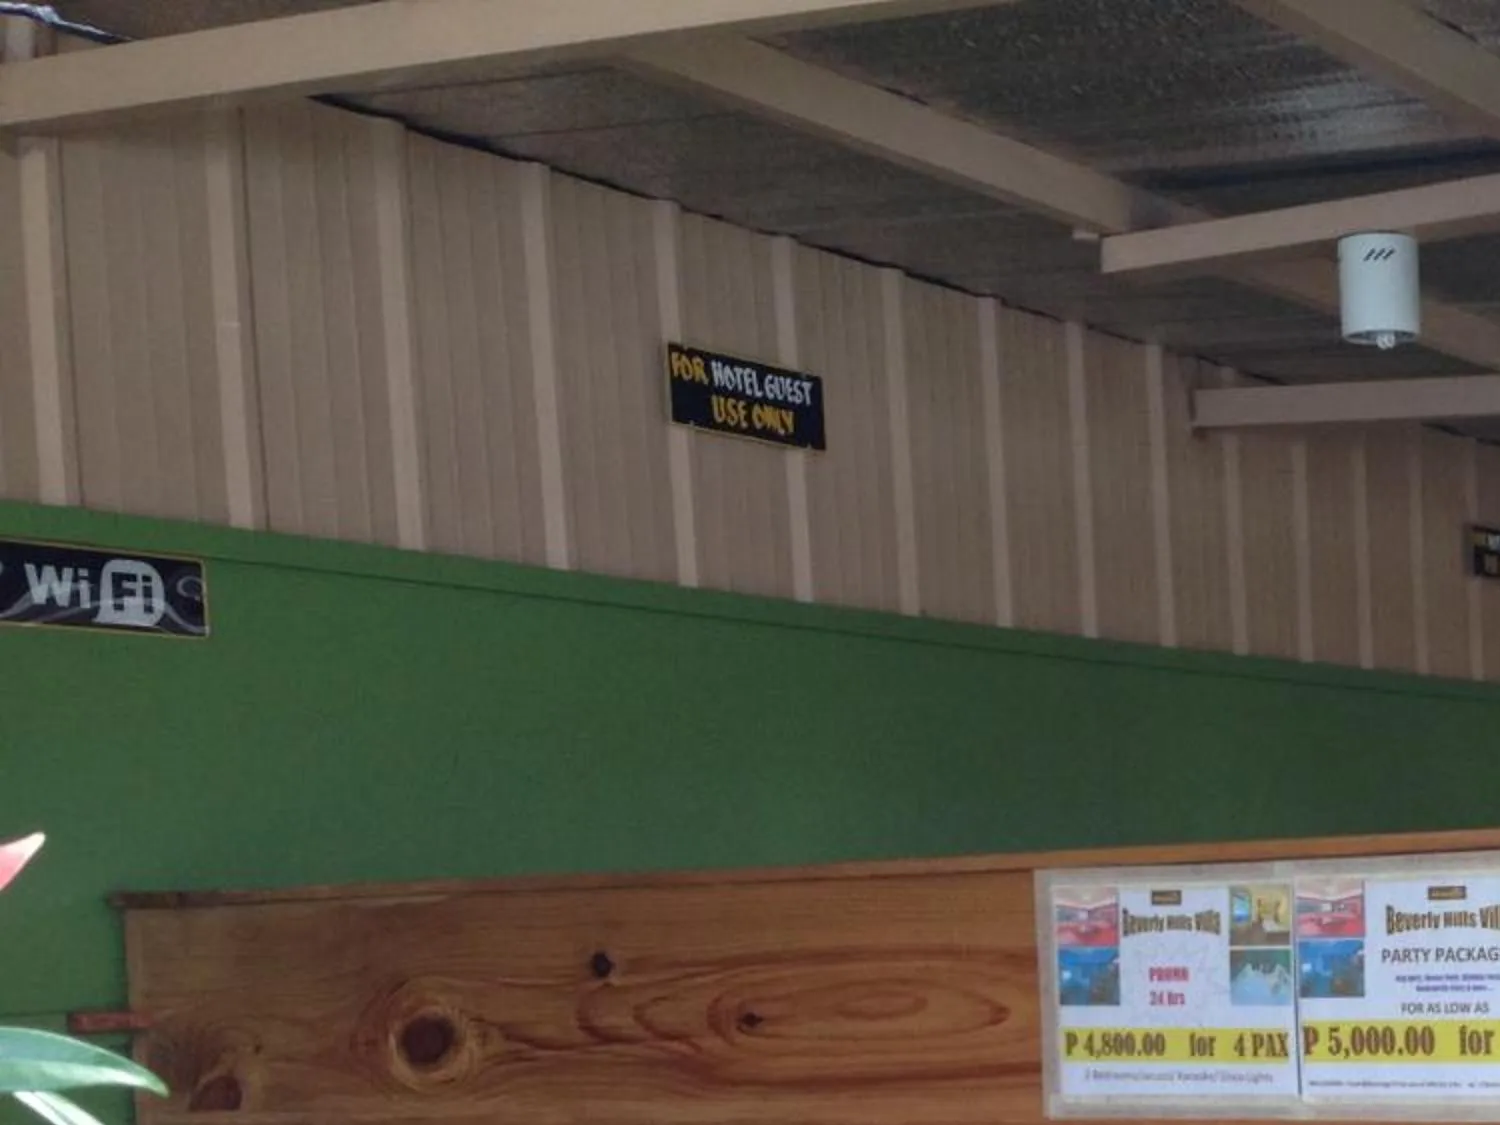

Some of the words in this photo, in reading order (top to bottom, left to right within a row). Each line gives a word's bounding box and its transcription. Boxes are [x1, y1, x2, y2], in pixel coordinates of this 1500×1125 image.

[671, 351, 709, 384] FOR
[711, 360, 764, 397] HOTEL
[764, 374, 814, 406] GUEST
[711, 395, 748, 429] USE
[752, 403, 796, 435] ONLY
[1386, 904, 1441, 935] Beverly
[1381, 947, 1431, 963] PARTY
[1402, 1002, 1424, 1015] FOR
[1426, 1002, 1441, 1014] AS
[1444, 1001, 1472, 1014] LOW
[1474, 1001, 1490, 1014] AS
[1083, 1031, 1166, 1059] 4,800.00
[1189, 1031, 1216, 1057] for
[1234, 1032, 1246, 1057] 4
[1252, 1031, 1290, 1057] PAX
[1327, 1025, 1435, 1059] 5,000.00
[1459, 1024, 1495, 1055] for
